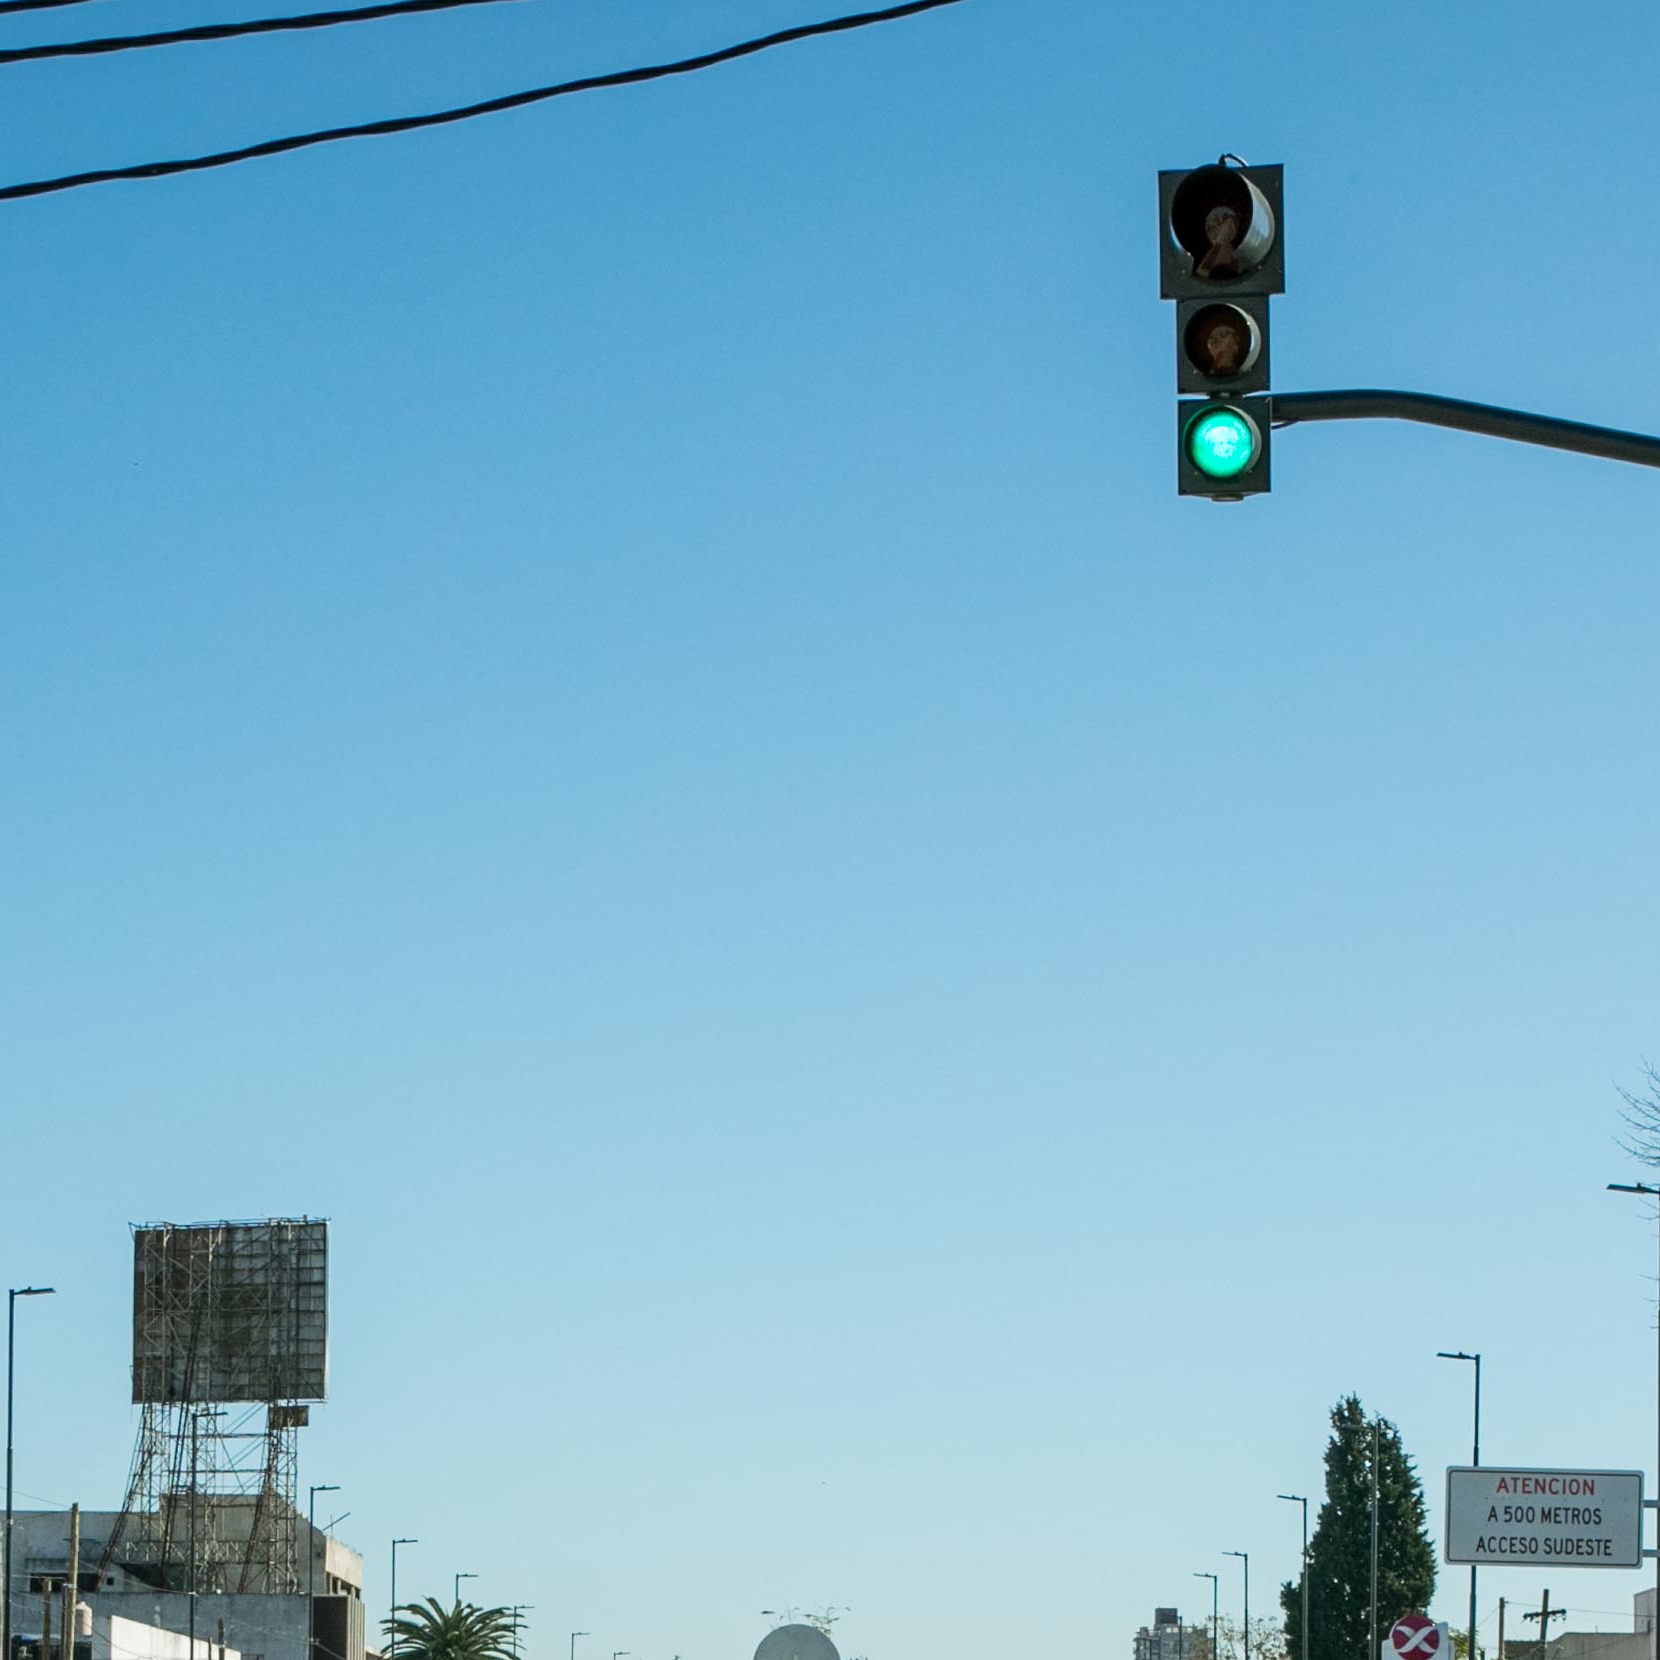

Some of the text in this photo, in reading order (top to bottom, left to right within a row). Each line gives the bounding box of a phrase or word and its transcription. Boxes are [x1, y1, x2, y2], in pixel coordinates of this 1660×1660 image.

[1496, 1477, 1595, 1496] ATENCION
[1487, 1505, 1602, 1525] A 500 METROS
[1476, 1536, 1612, 1556] ACCESO SUDESTE
